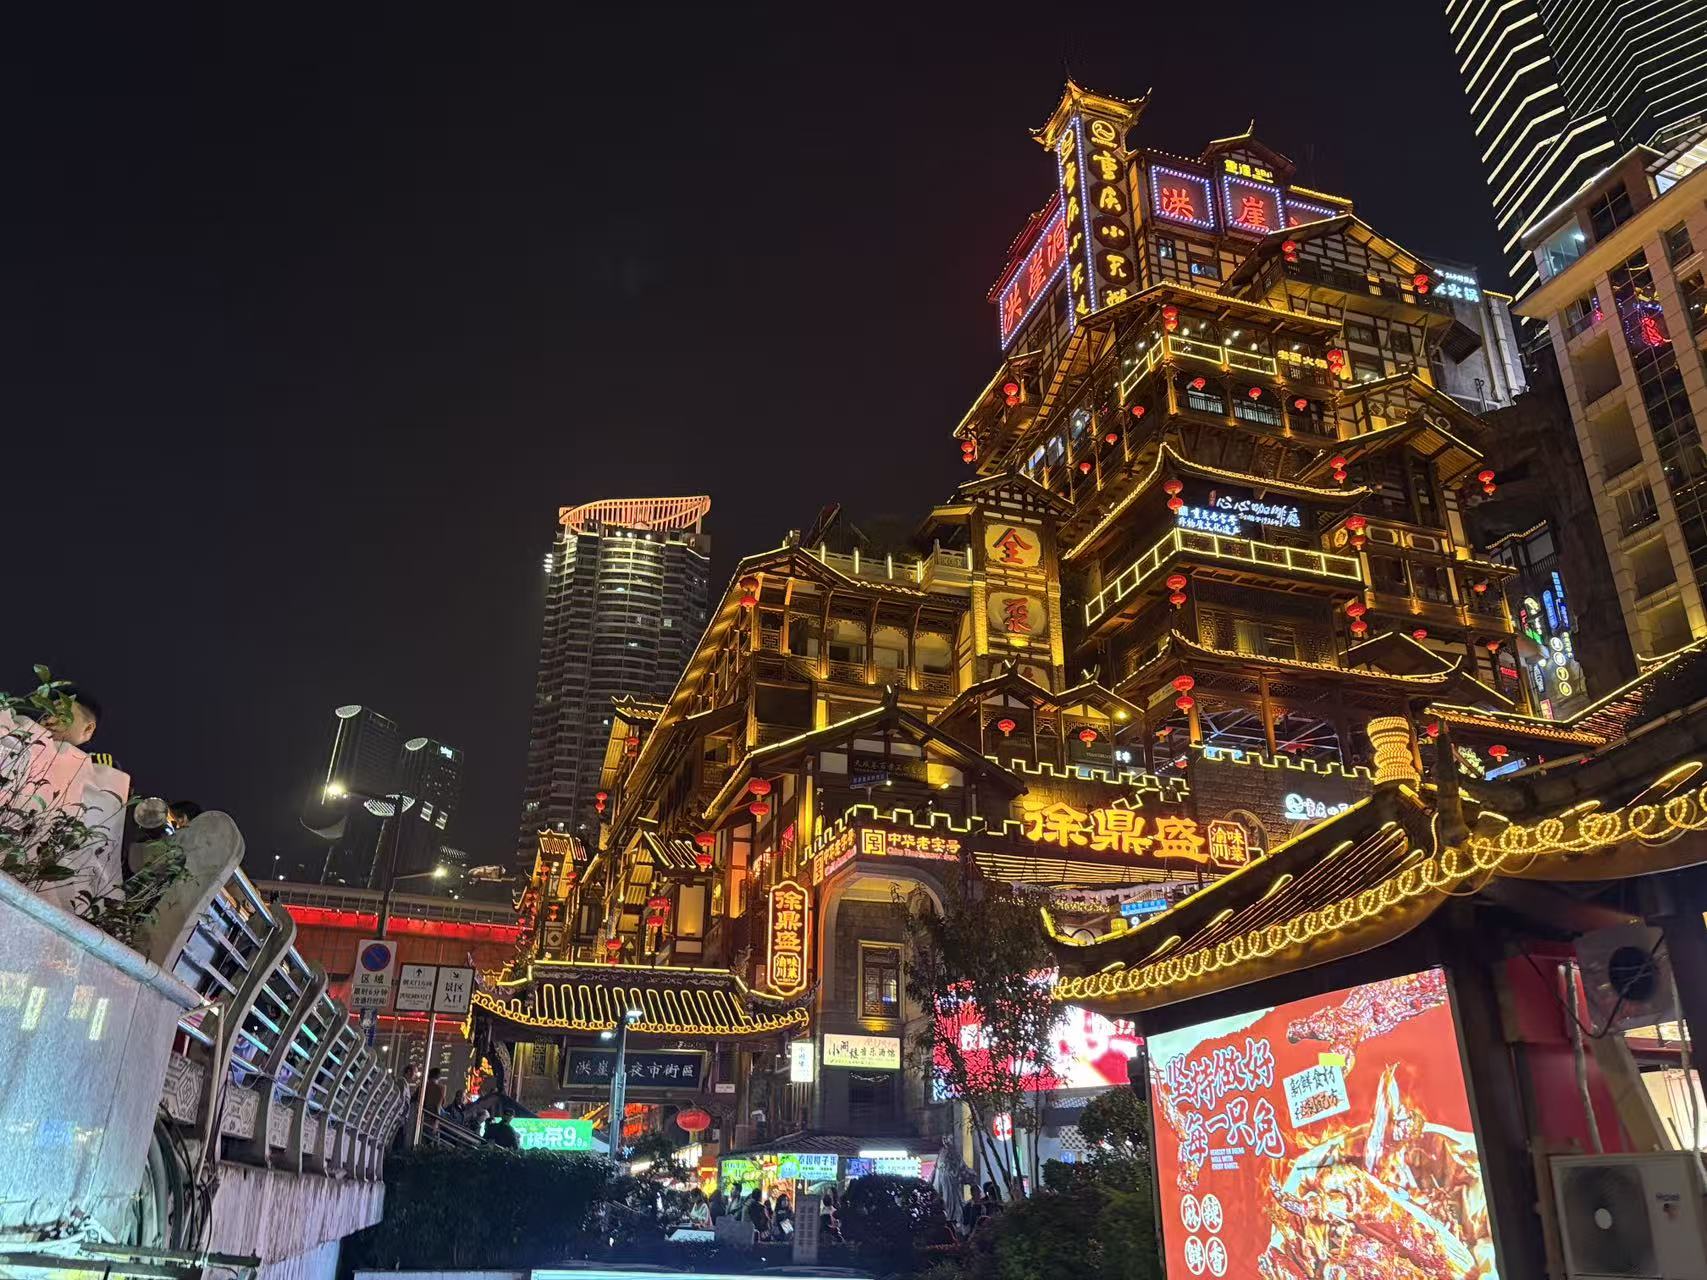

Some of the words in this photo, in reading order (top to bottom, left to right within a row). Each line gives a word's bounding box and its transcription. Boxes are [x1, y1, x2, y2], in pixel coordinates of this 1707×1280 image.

[1162, 187, 1299, 230] 洪崖
[887, 832, 961, 853] 中华老字号
[1022, 800, 1211, 864] 徐鼎盛
[774, 890, 803, 953] 徐鼎盛
[444, 994, 462, 1003] 入口
[1165, 1037, 1274, 1110] 坚持做好
[1182, 1096, 1285, 1167] 每一只兔
